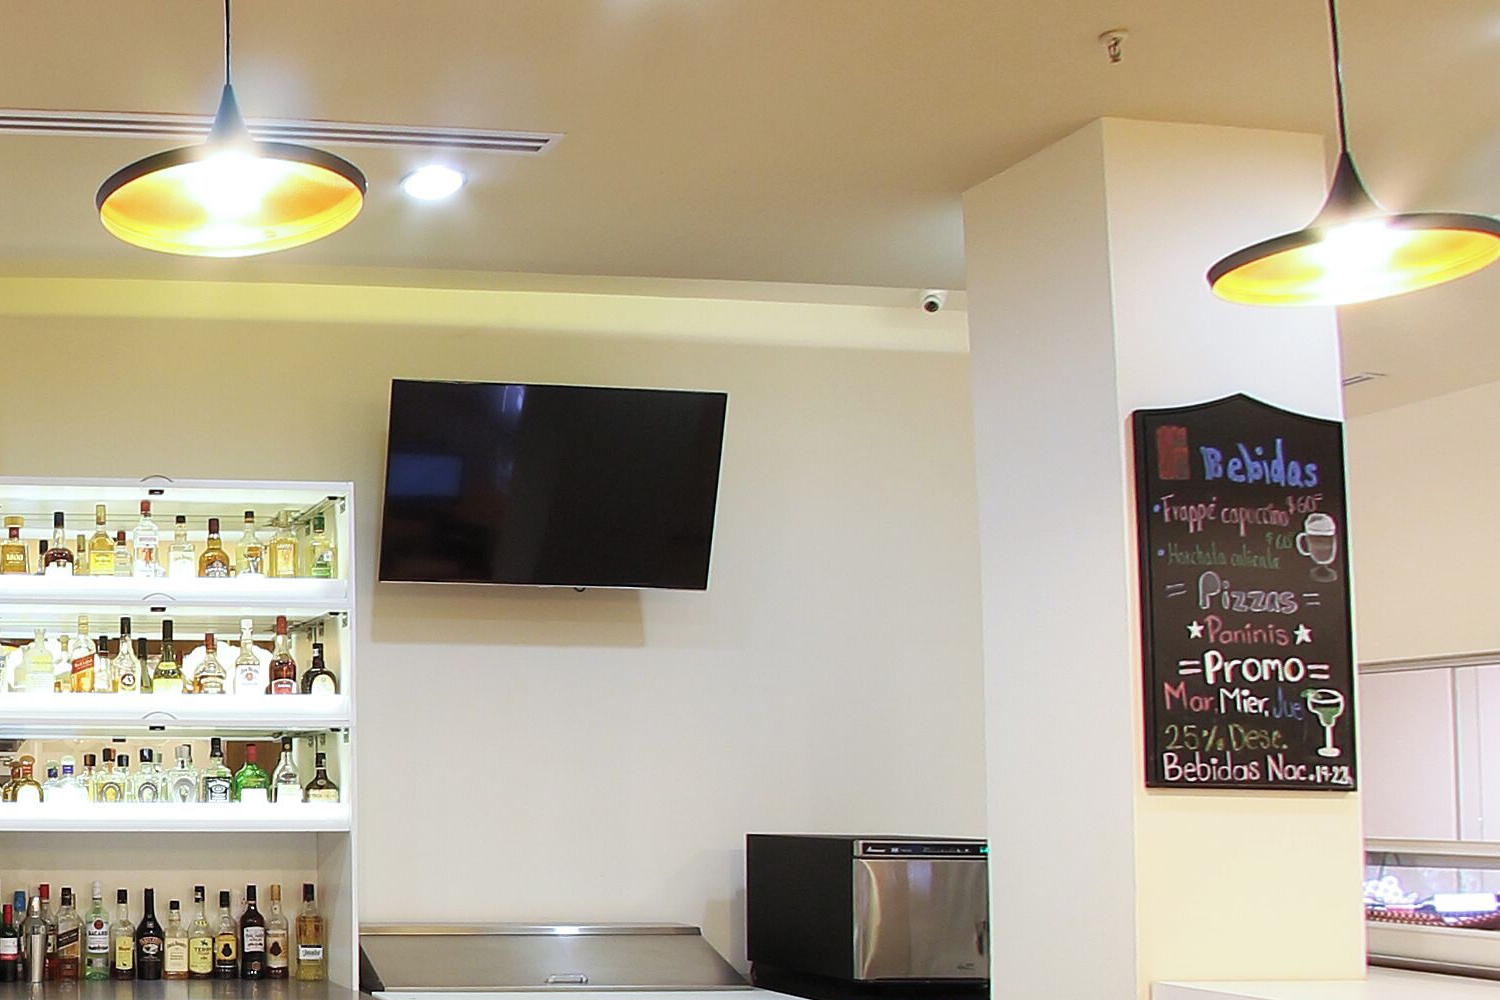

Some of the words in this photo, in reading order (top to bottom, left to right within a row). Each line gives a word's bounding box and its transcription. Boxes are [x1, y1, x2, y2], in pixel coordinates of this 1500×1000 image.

[1200, 438, 1318, 487] Bebidas
[1198, 571, 1299, 614] Pizzas
[1204, 650, 1306, 685] Promo
[1162, 751, 1261, 782] Bebidas
